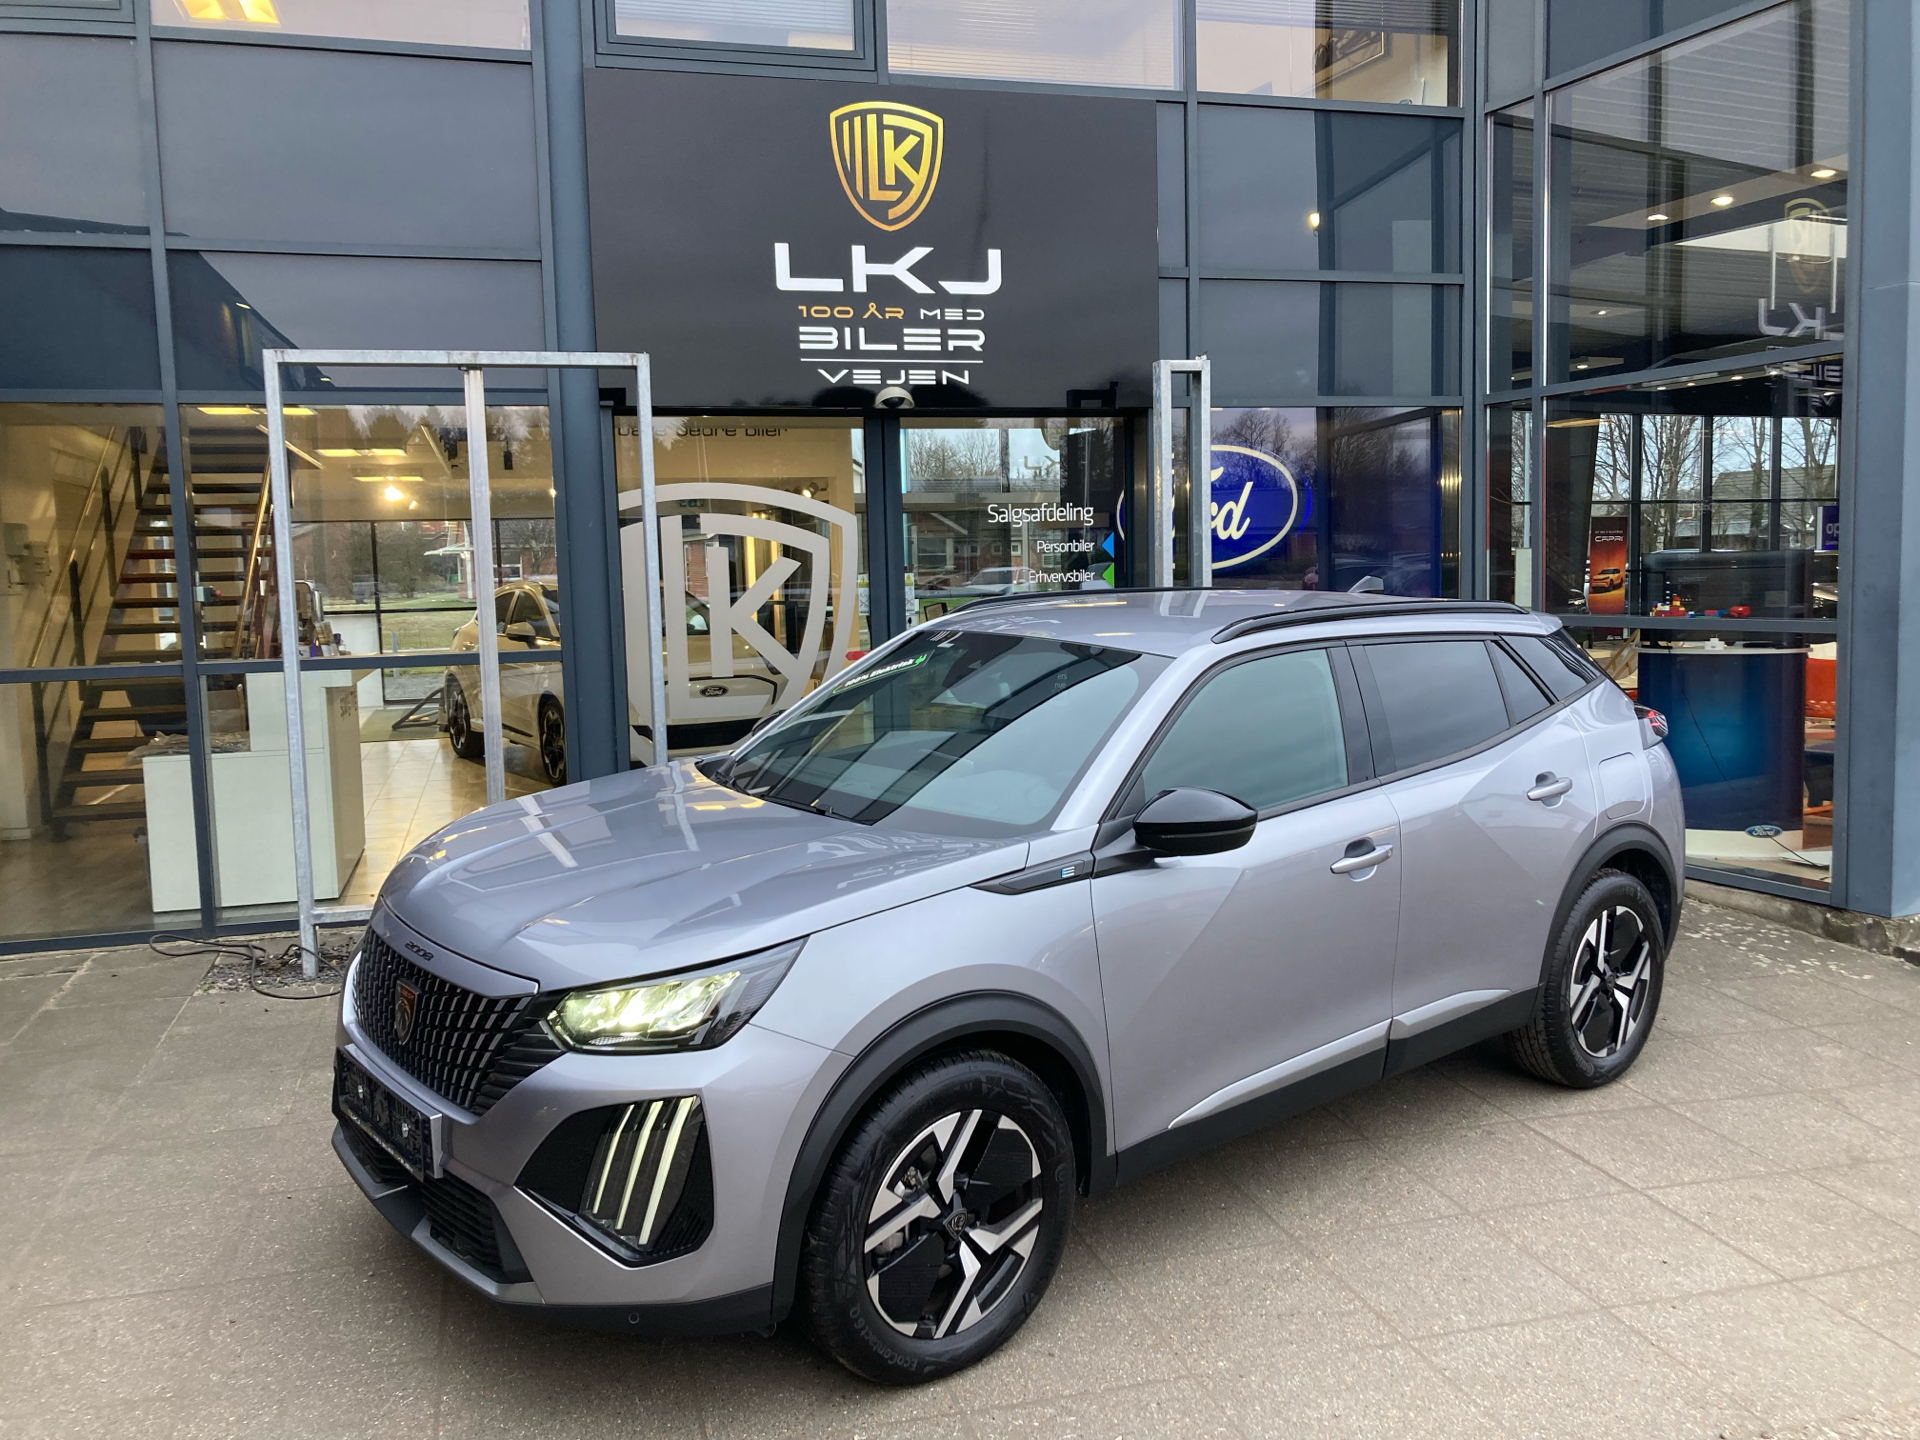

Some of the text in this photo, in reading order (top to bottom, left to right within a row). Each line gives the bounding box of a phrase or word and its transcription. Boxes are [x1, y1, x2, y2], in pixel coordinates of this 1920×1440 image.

[774, 242, 1002, 295] LKJ
[798, 302, 985, 321] 100 ÅR MED
[799, 326, 986, 352] BILER
[817, 368, 970, 385] VEJEN
[987, 502, 1094, 528] Salgsafdeling
[1037, 540, 1095, 553] Personbiler
[1029, 570, 1095, 583] Erhvervsbiler
[404, 941, 434, 961] 2008
